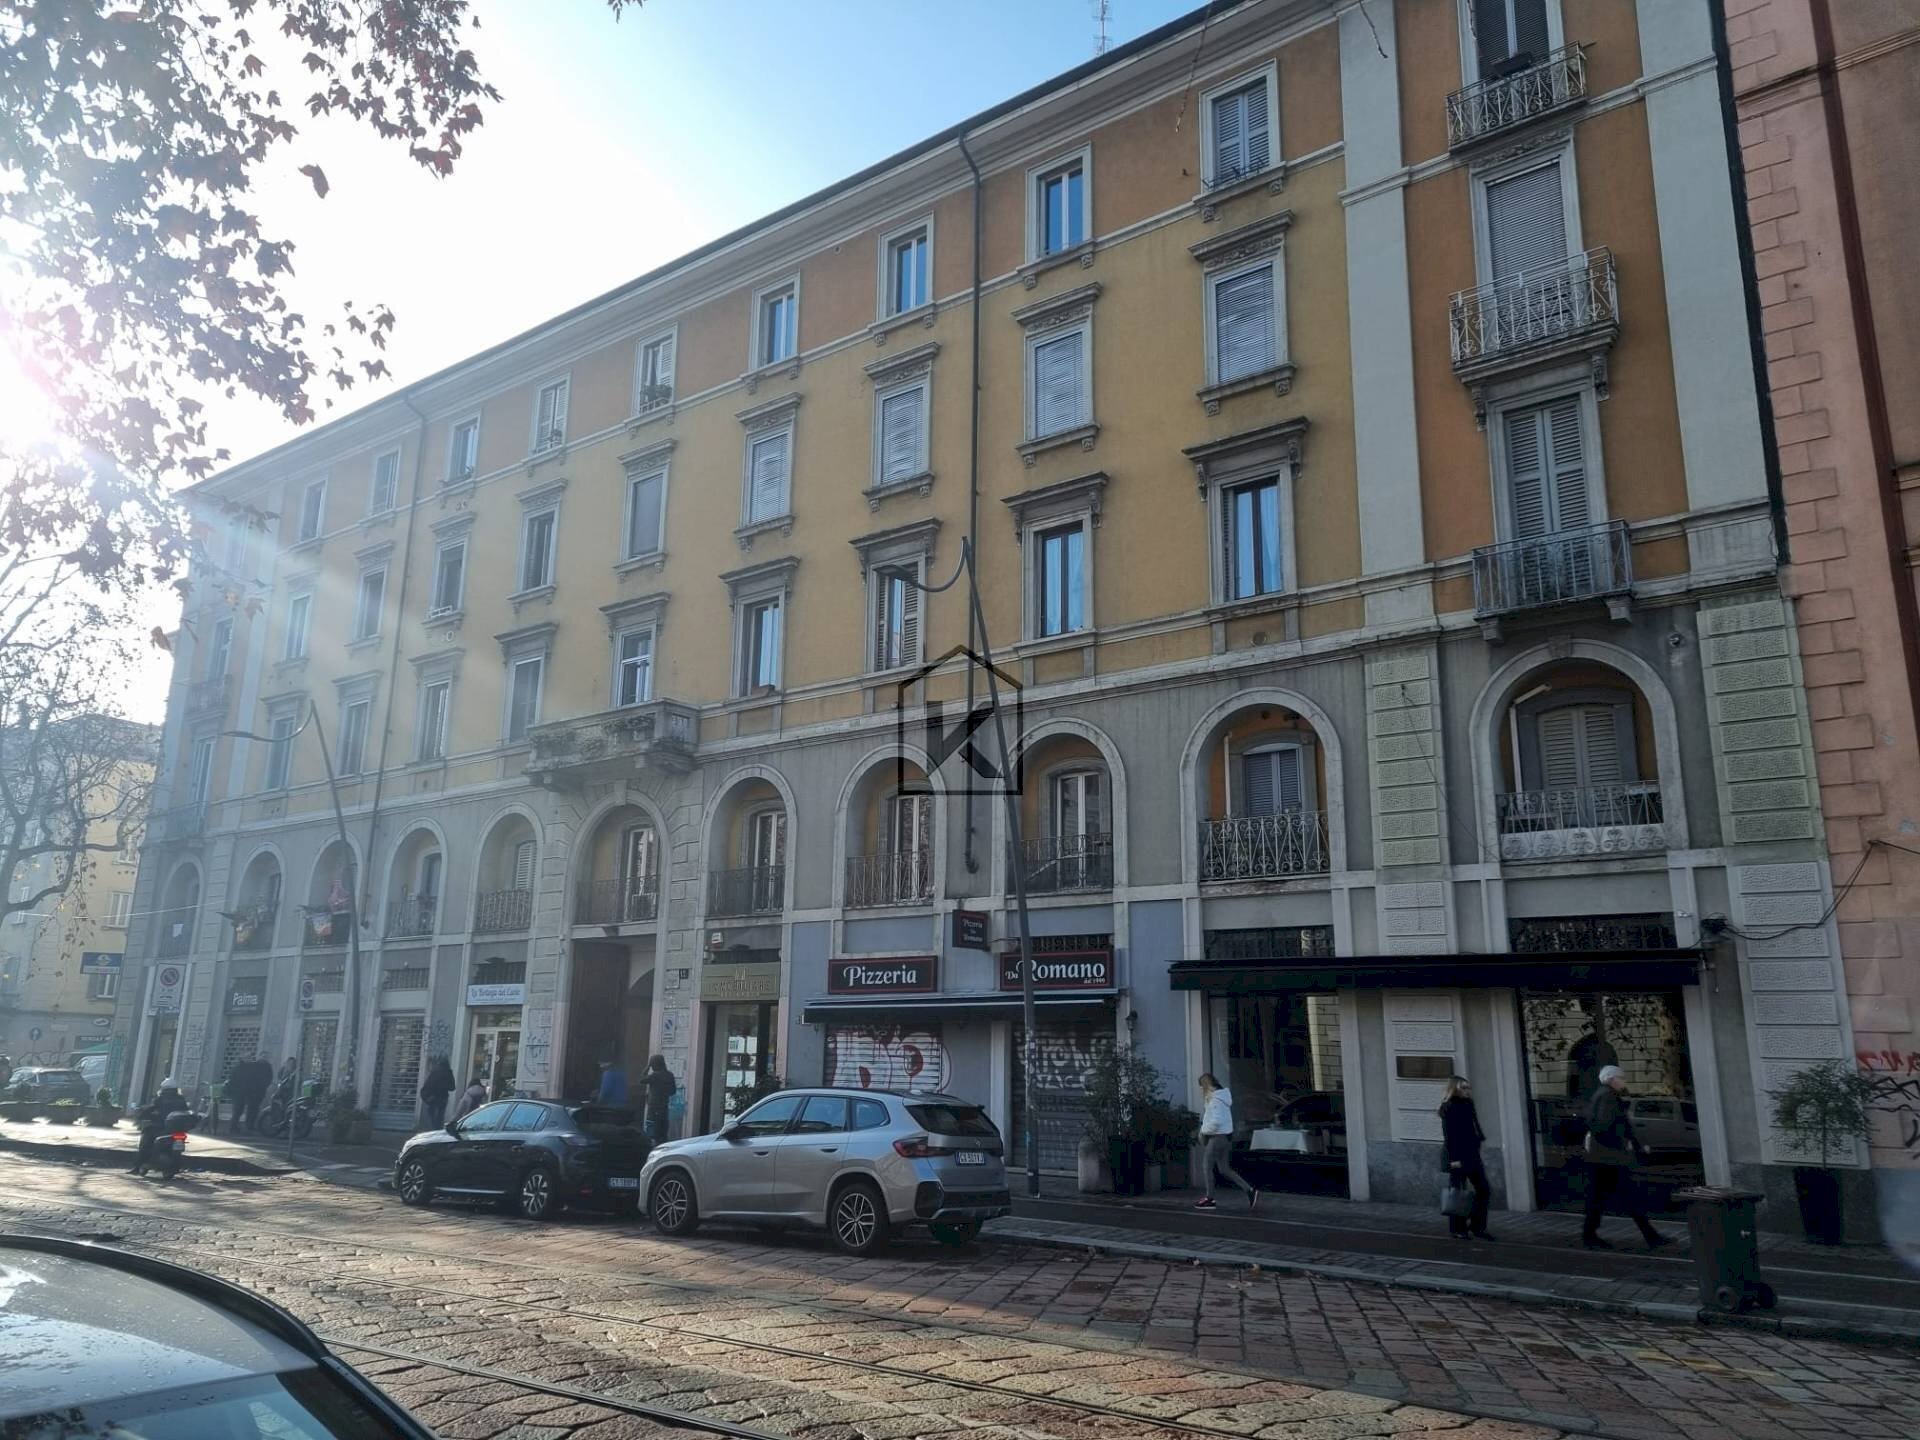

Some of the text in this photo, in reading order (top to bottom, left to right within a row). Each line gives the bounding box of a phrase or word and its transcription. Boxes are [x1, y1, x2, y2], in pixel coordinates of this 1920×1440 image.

[843, 963, 917, 987] Pizzeria
[1005, 959, 1105, 982] Da Romano
[232, 992, 259, 1007] Palma
